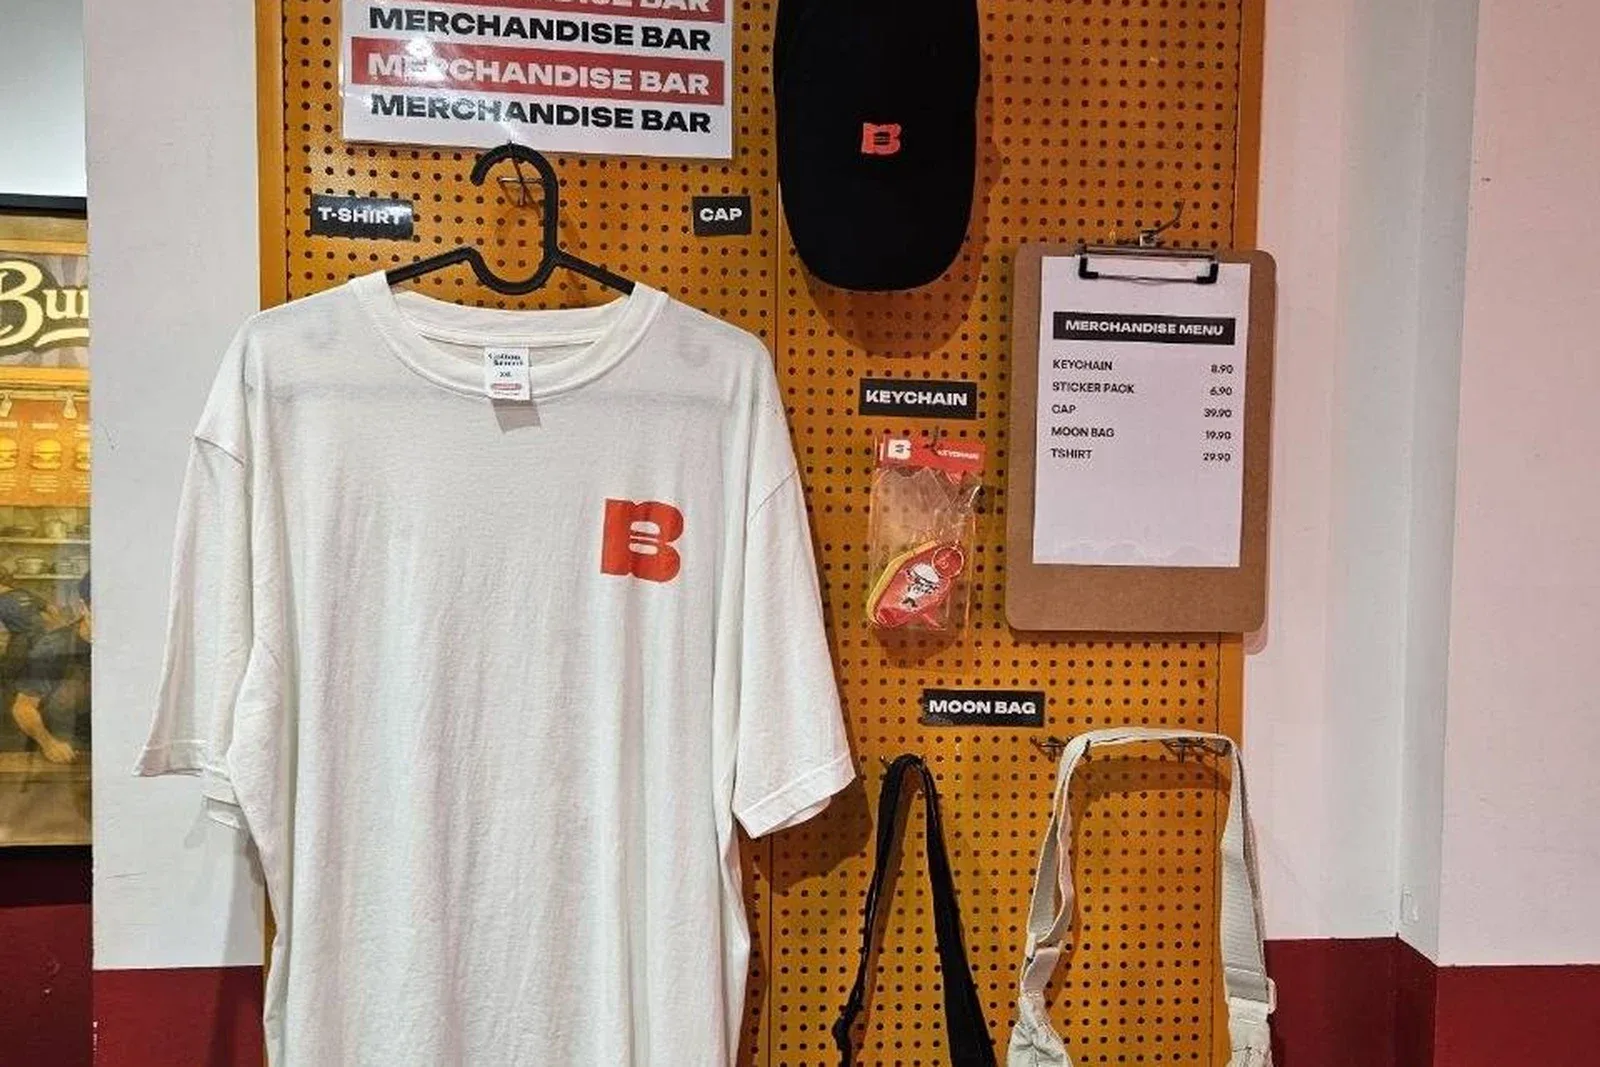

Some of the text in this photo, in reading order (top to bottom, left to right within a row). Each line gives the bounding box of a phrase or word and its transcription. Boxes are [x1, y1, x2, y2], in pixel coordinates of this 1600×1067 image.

[369, 7, 711, 51] MERCHANDISE BAR
[367, 52, 710, 96] MERCHANDISE BAR
[370, 93, 711, 133] MERCHANDISE BAR
[861, 122, 902, 155] B
[318, 206, 403, 225] T-SHIRT
[699, 207, 743, 223] CAP
[1065, 319, 1224, 336] MERCHANDISE MENU
[1052, 359, 1234, 374] KEYCHAIN 8.90
[1052, 381, 1232, 396] STICKER PACK 6.90
[865, 389, 968, 407] KEYCHAIN
[1051, 404, 1232, 418] CAP 39.90
[1051, 426, 1231, 440] MOON BAG 19.90
[1051, 448, 1231, 462] TSHIRT 29.90
[600, 498, 684, 583] B
[928, 699, 1036, 715] MOON BAG
